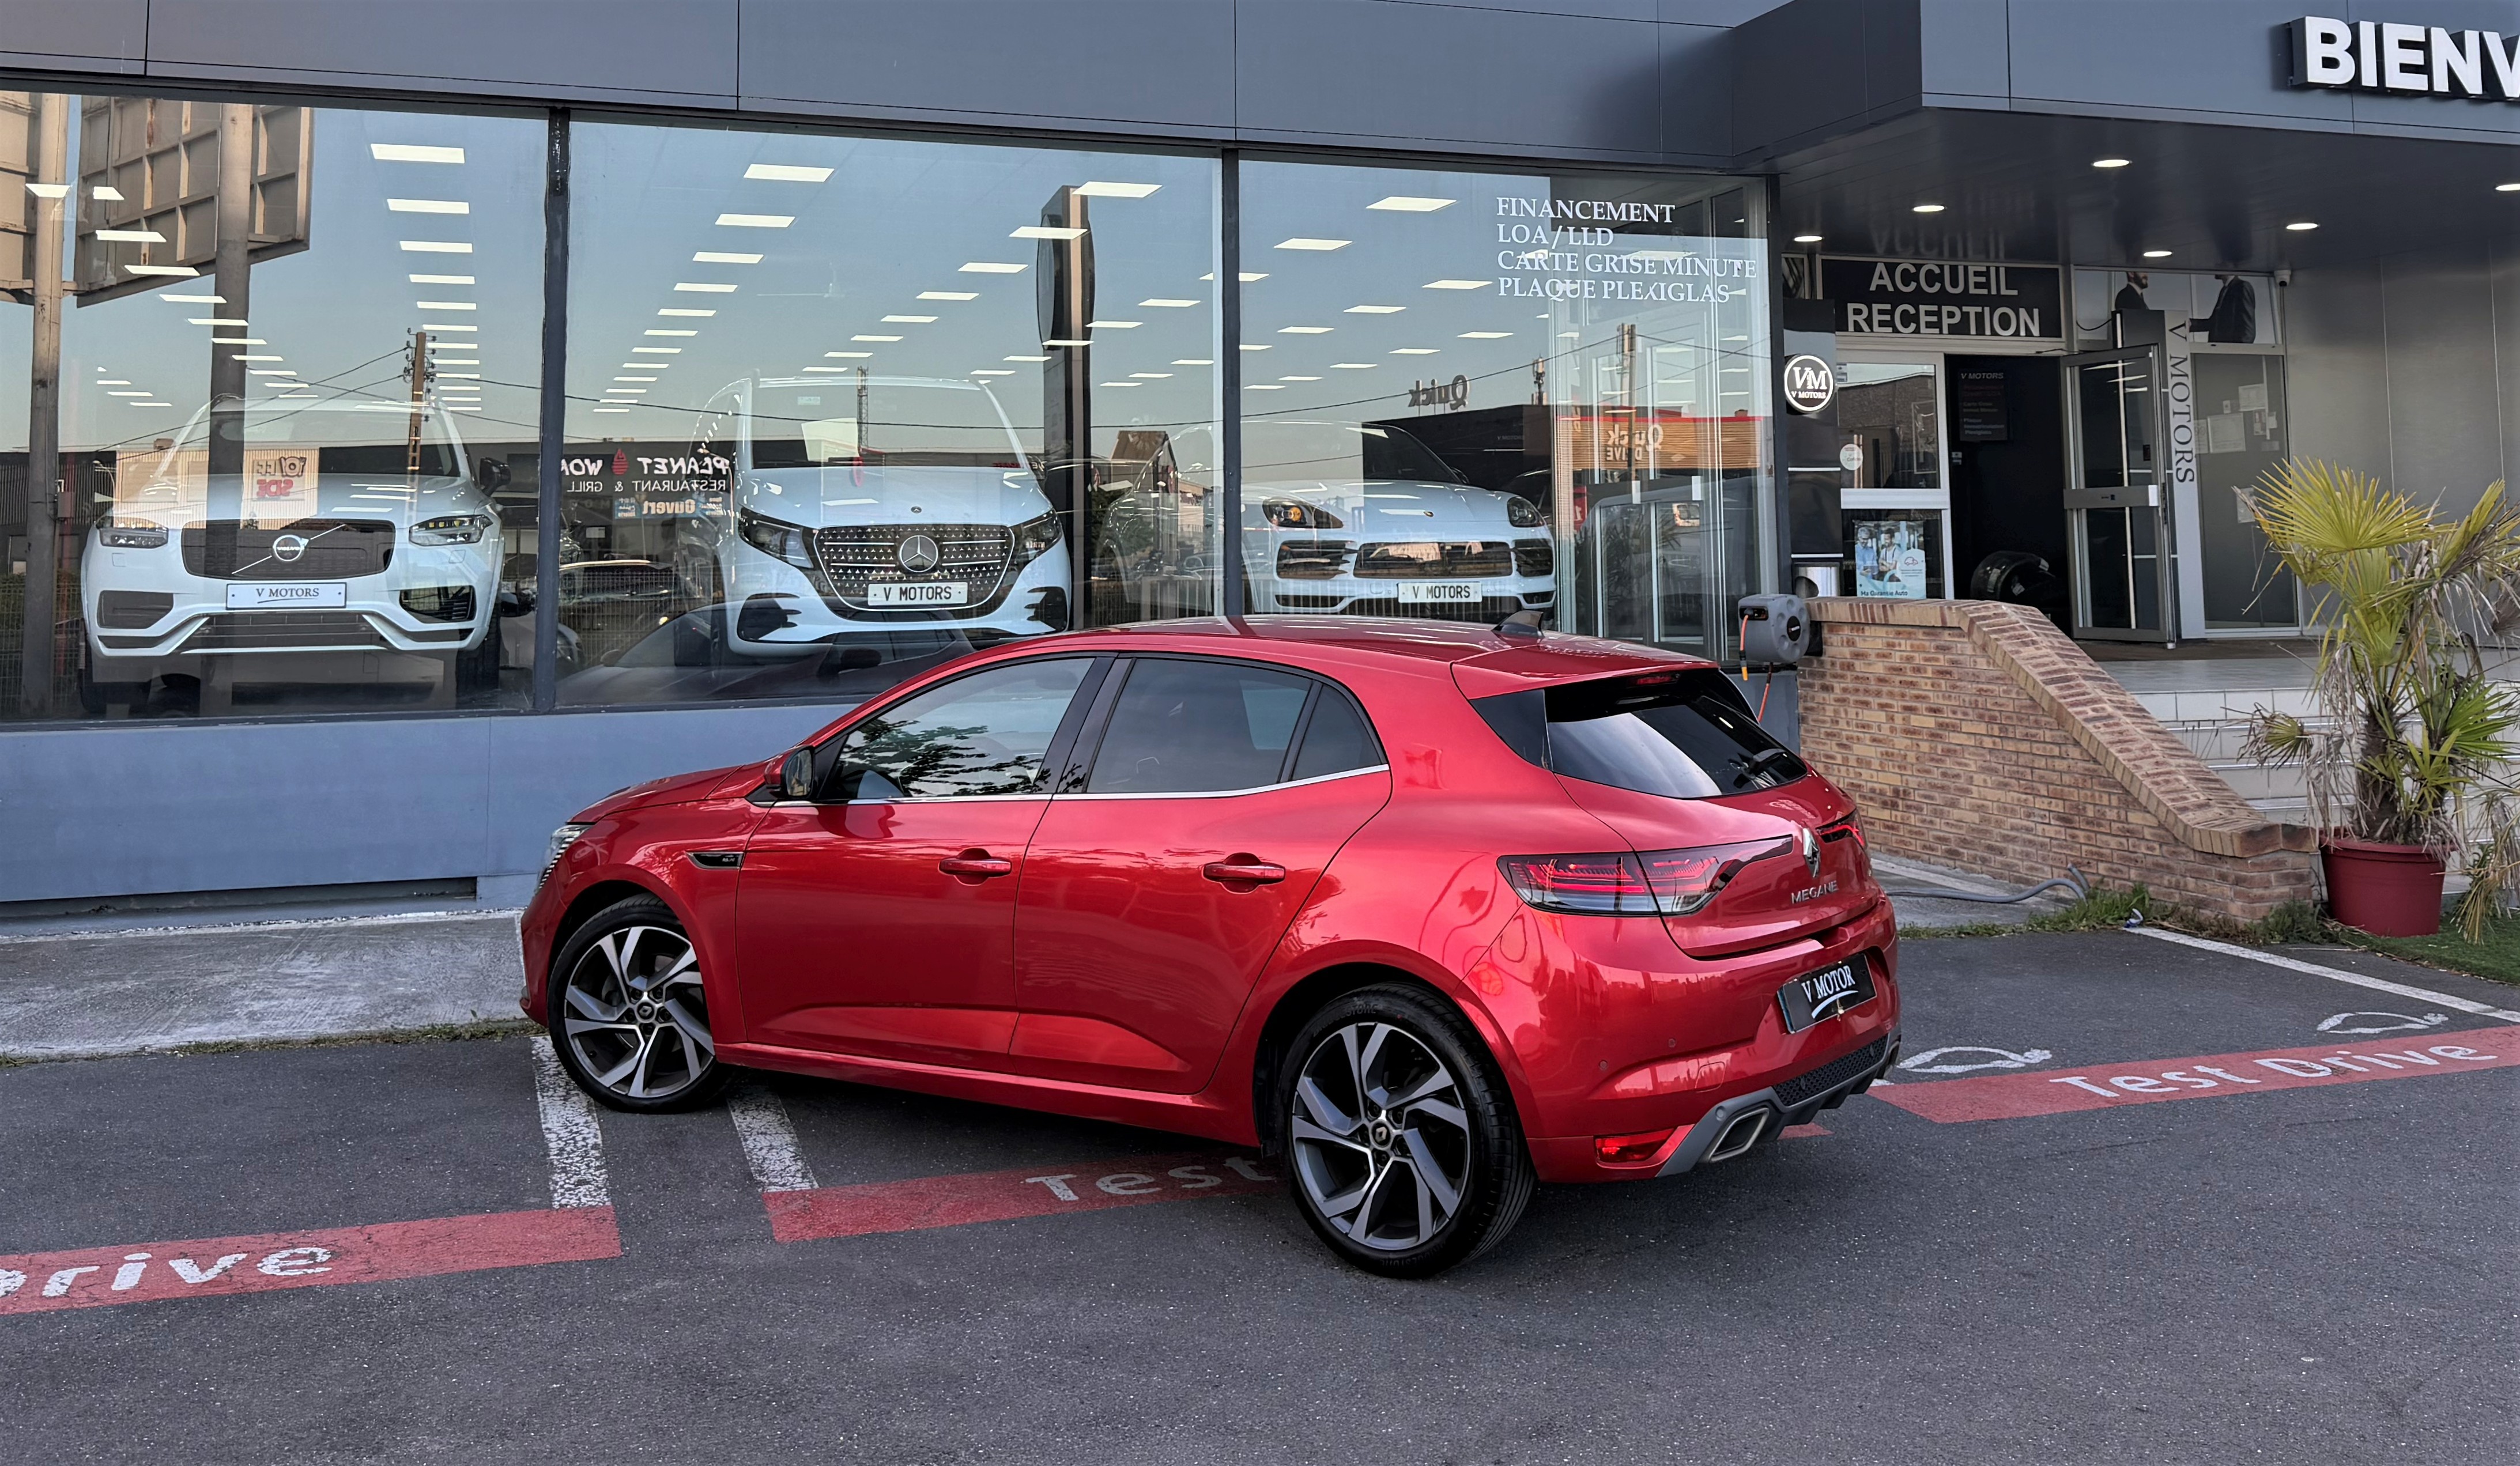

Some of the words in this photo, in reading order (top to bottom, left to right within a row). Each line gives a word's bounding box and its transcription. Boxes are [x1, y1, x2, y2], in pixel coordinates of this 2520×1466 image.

[2305, 16, 2520, 98] BIENV
[1496, 197, 1676, 224] FINANCEMENT
[1497, 251, 1579, 272] CARTE
[1585, 254, 1657, 275] GRISE
[1662, 257, 1757, 278] MINUTE
[1498, 277, 1596, 303] PLAQUE
[1602, 282, 1730, 303] PLEXIGLAS
[1869, 262, 2019, 296] ACCUEIL
[1847, 303, 2040, 337] RECEPTION
[2168, 320, 2187, 342] V
[1793, 366, 1828, 390] VM
[1798, 391, 1827, 399] MOTORS
[2170, 354, 2195, 483] MOTORS
[256, 588, 265, 597] V
[269, 588, 320, 597] MOTORS
[883, 587, 892, 602] V
[899, 586, 952, 601] MOTORS
[1412, 585, 1420, 599] V
[1426, 585, 1470, 599] MOTORS
[1791, 880, 1839, 904] MEGANE
[1801, 980, 1812, 1003] V
[1813, 965, 1855, 999] MOTOR
[2049, 1065, 2261, 1098] Test
[2253, 1045, 2498, 1078] Drive
[1025, 1157, 1278, 1201] Test
